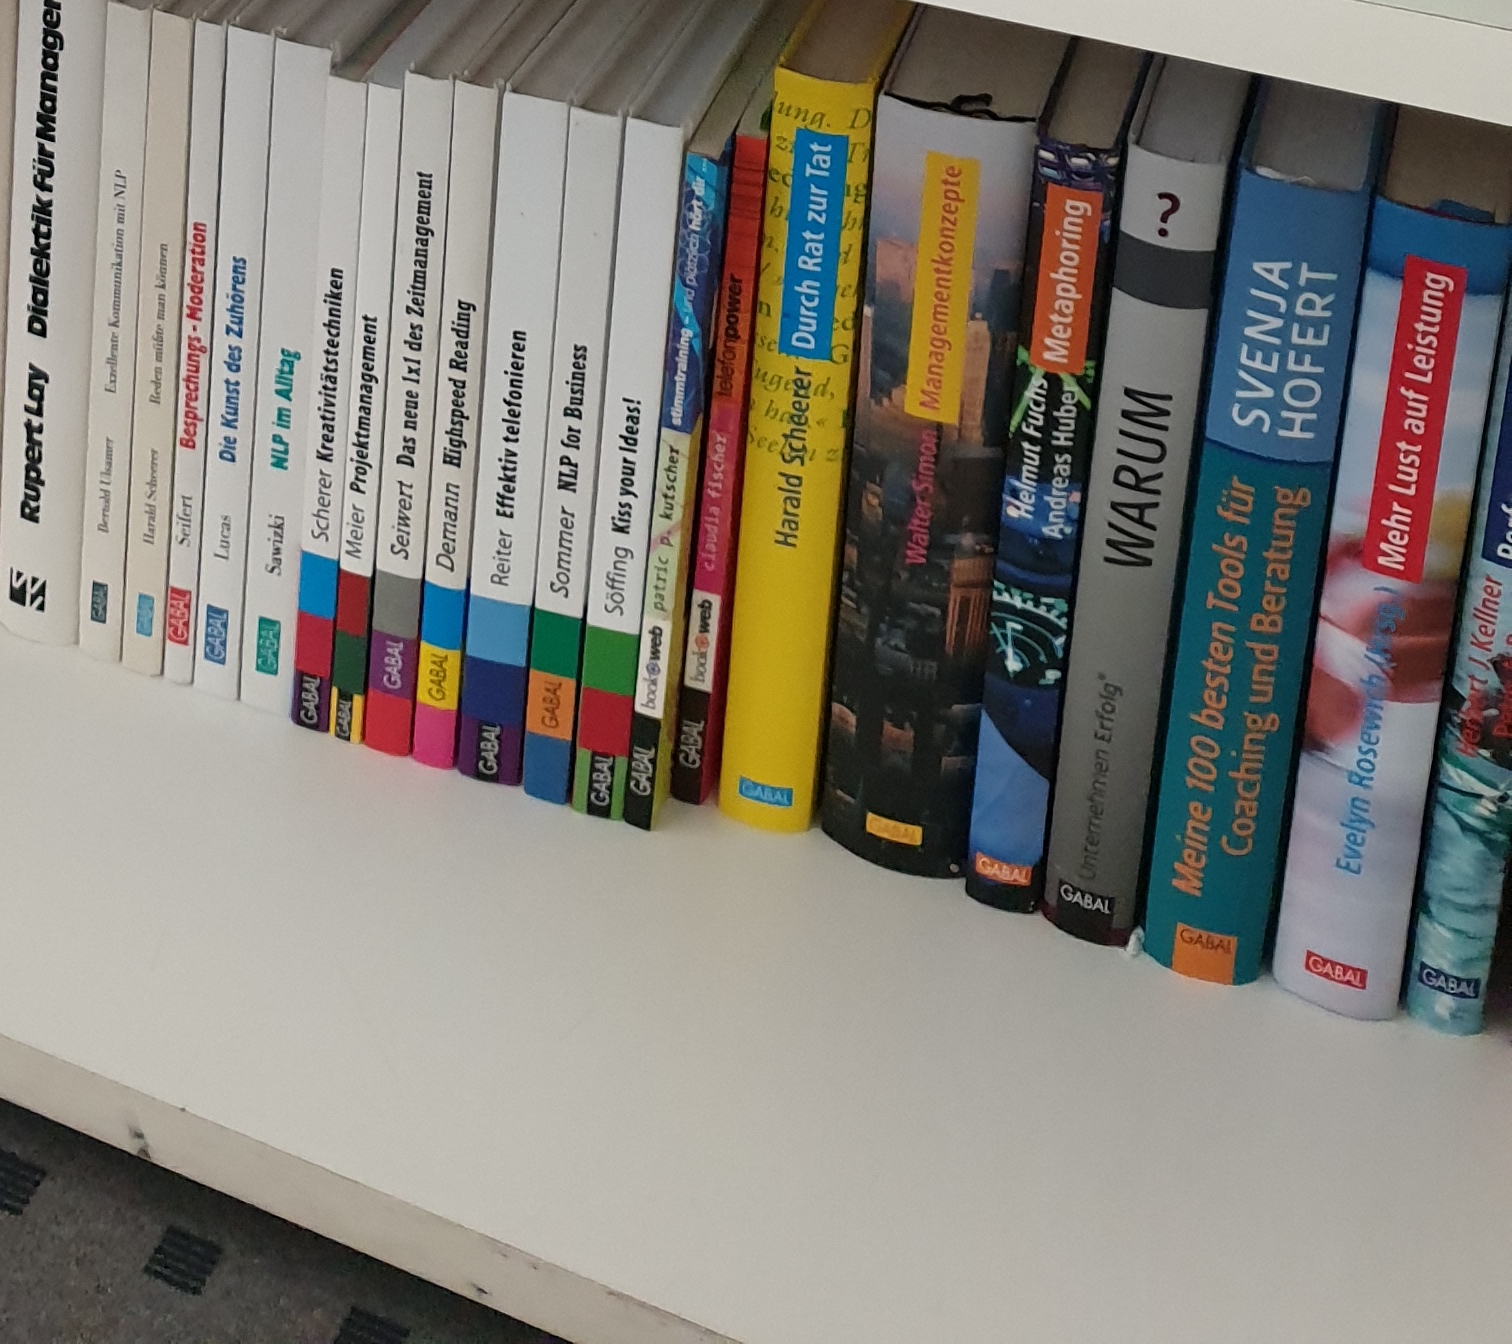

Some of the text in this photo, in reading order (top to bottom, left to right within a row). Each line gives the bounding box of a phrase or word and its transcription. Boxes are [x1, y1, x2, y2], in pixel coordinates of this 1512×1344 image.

[30, 143, 58, 191] für
[790, 142, 832, 349] Durch Rat zur Tat
[25, 196, 56, 337] Dialektik
[919, 166, 962, 408] Managementkonzepte
[1044, 199, 1088, 362] Metaphoring
[1233, 261, 1291, 433] SVENJA
[1278, 263, 1336, 439] HOFERT
[19, 419, 45, 523] Rupert
[24, 363, 49, 413] Lay
[311, 268, 345, 542] Scherer Kreativitätstechniken
[345, 316, 378, 559] Meier Projektmanagement
[436, 300, 475, 572] Demann Highspeed Reading
[489, 331, 529, 587] Reiter Effektiv telefonieren
[774, 367, 812, 547] Harald Scheerer
[1103, 388, 1173, 569] WARUM
[1378, 273, 1453, 569] Mehr Lust auf Leistung
[1174, 476, 1253, 895] Meine 100 besten Tools für
[1226, 488, 1308, 856] Coaching und Beratung
